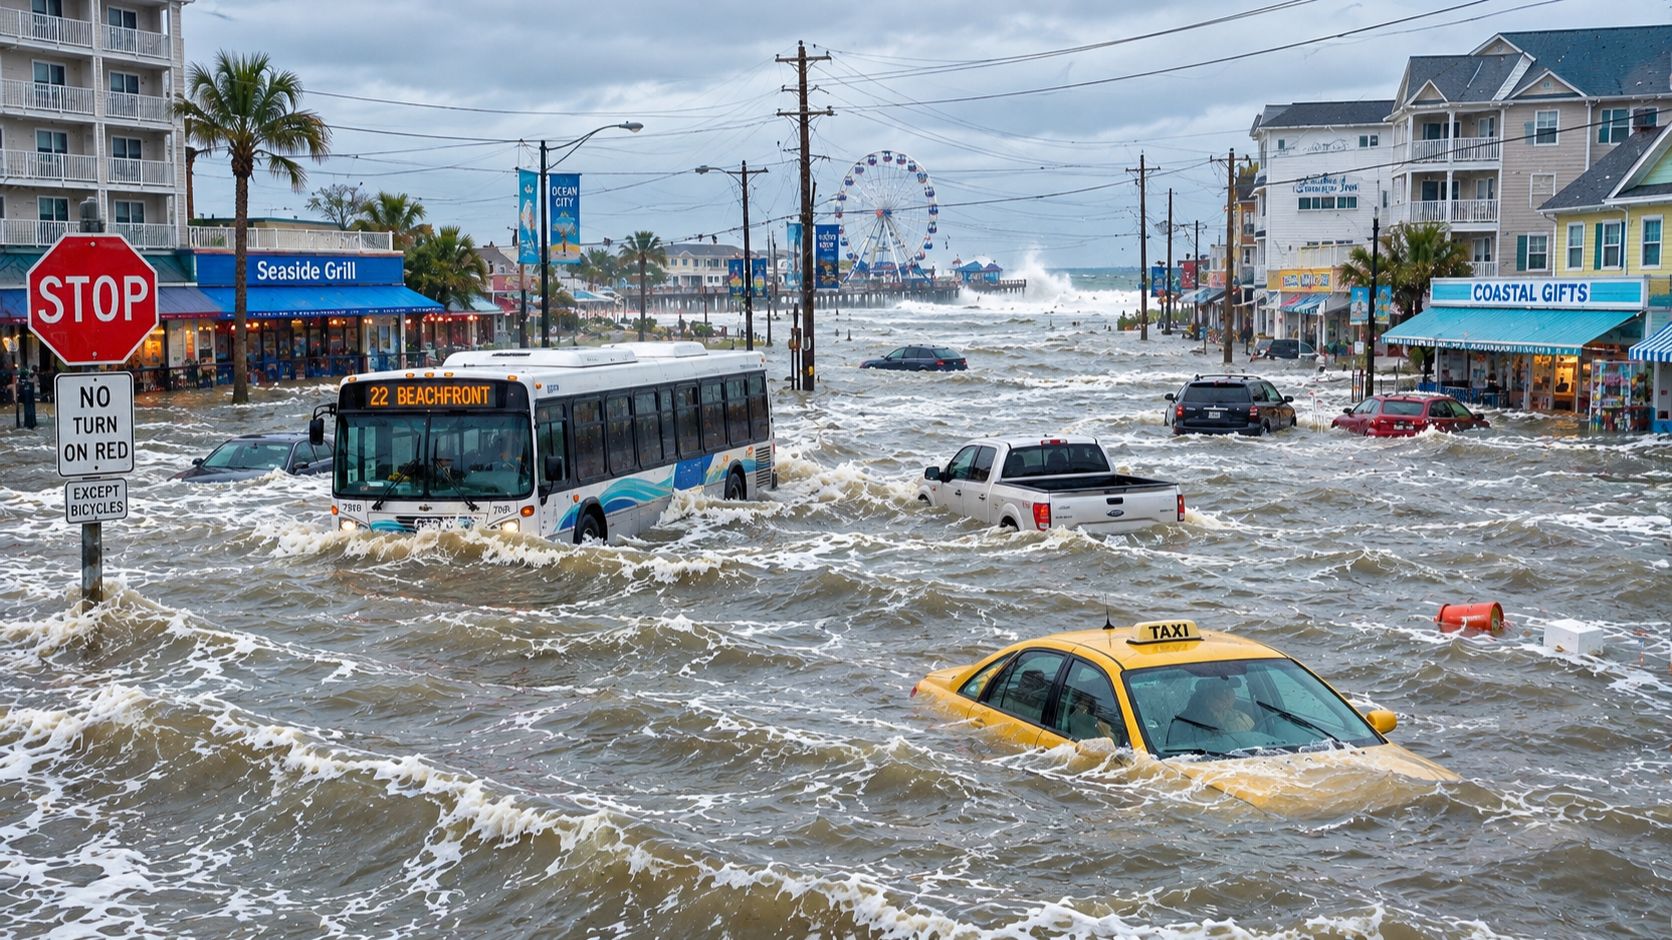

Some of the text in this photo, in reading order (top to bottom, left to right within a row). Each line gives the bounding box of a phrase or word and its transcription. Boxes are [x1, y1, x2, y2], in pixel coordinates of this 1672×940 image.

[551, 186, 578, 197] OCEAN
[555, 197, 574, 208] CITY
[257, 260, 356, 281] Seaside Grill
[38, 275, 149, 324] STOP
[1473, 284, 1588, 303] COASTAL GIFTS
[80, 385, 111, 409] NO
[370, 385, 490, 406] 22 BEACHFRONT
[73, 416, 118, 434] TURN
[64, 440, 129, 462] ON RED
[73, 484, 119, 501] EXCEPT
[71, 500, 124, 516] BICYCLES
[1148, 623, 1189, 641] TAXI
